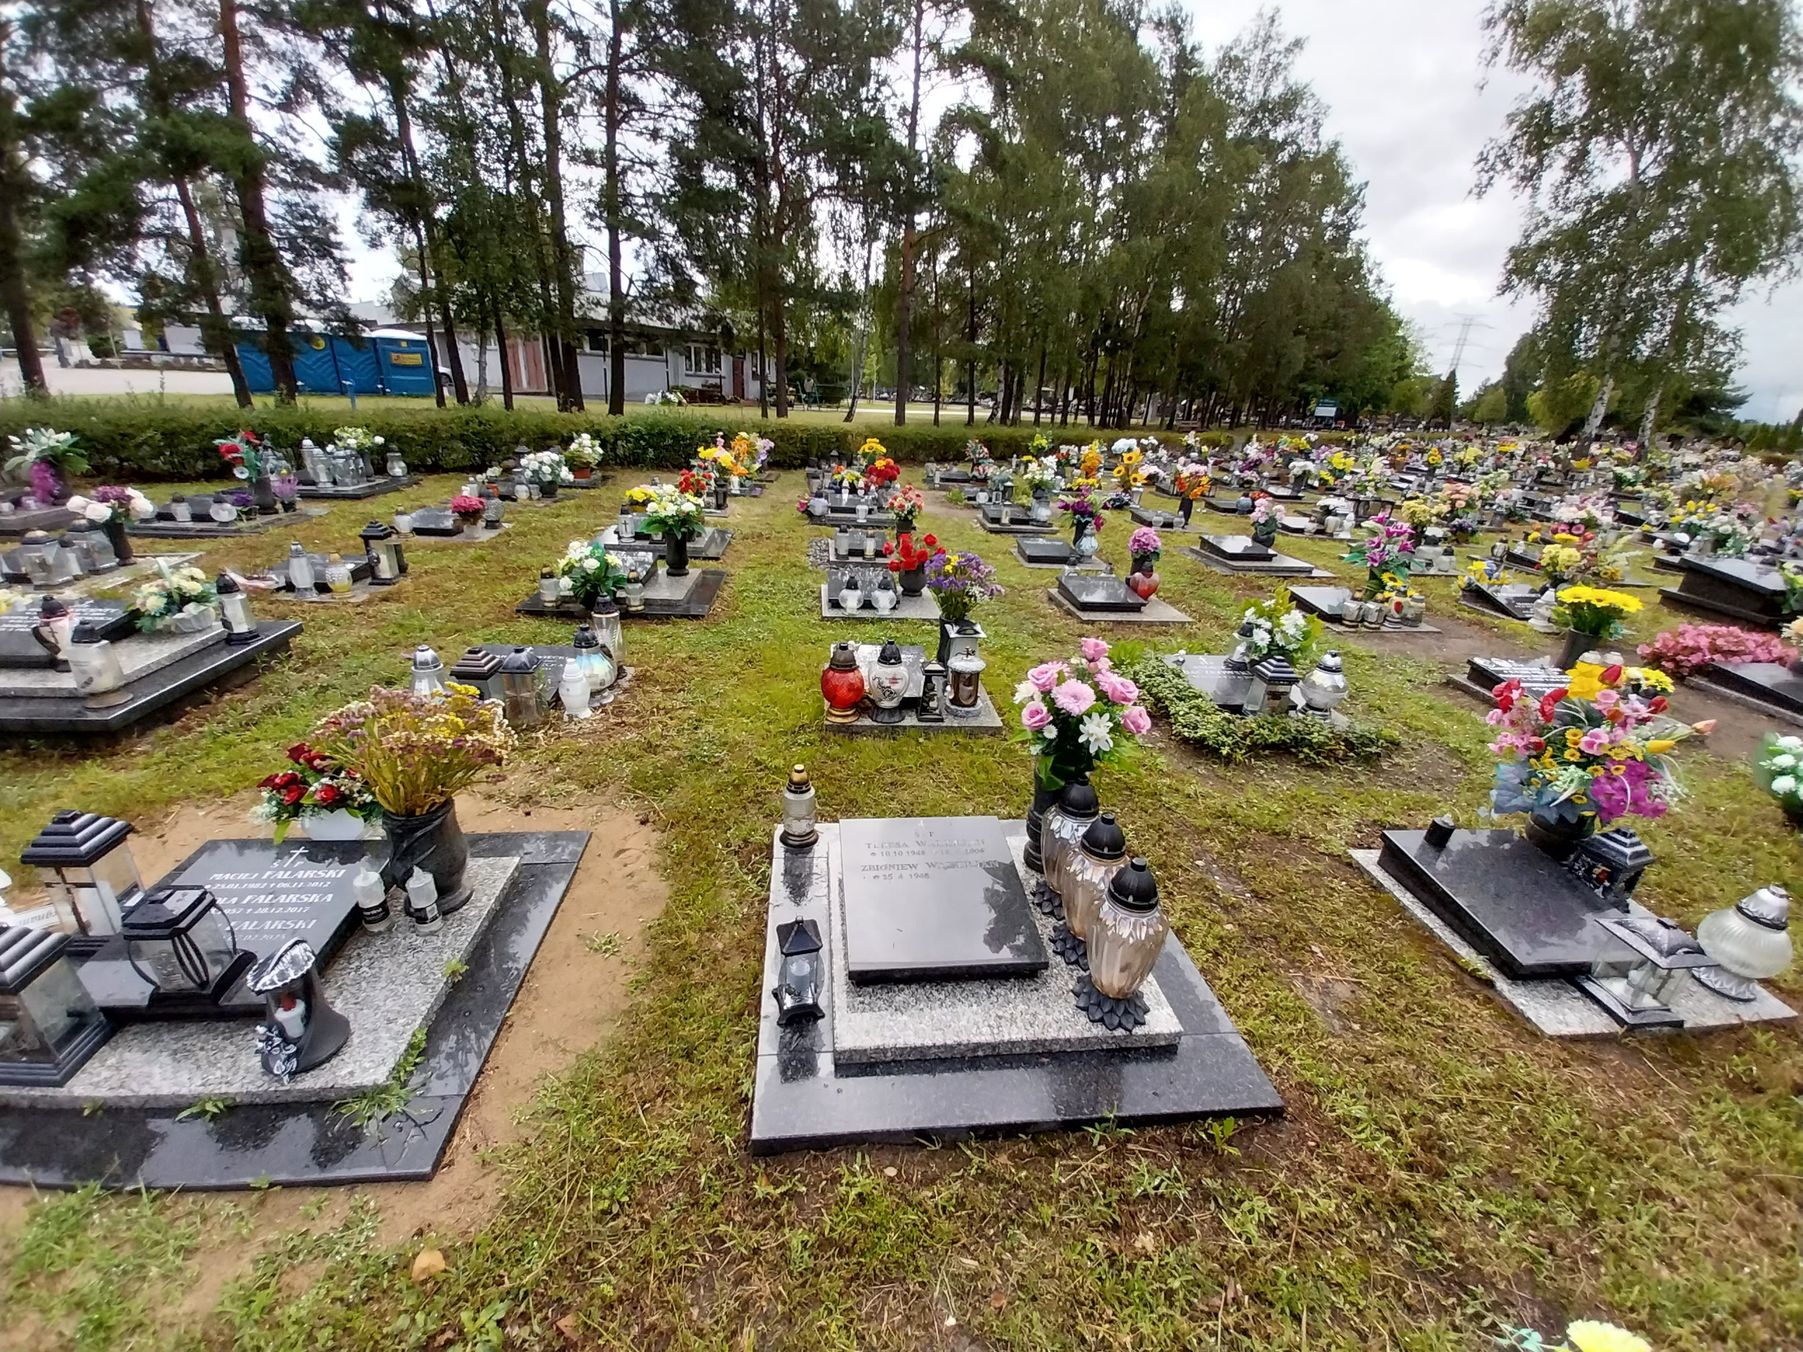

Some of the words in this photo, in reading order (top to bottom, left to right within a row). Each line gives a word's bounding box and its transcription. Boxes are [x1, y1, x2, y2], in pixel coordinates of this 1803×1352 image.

[209, 872, 259, 881] MACIEJ
[261, 869, 346, 879] FALARSKI
[241, 893, 334, 905] FALARSKA
